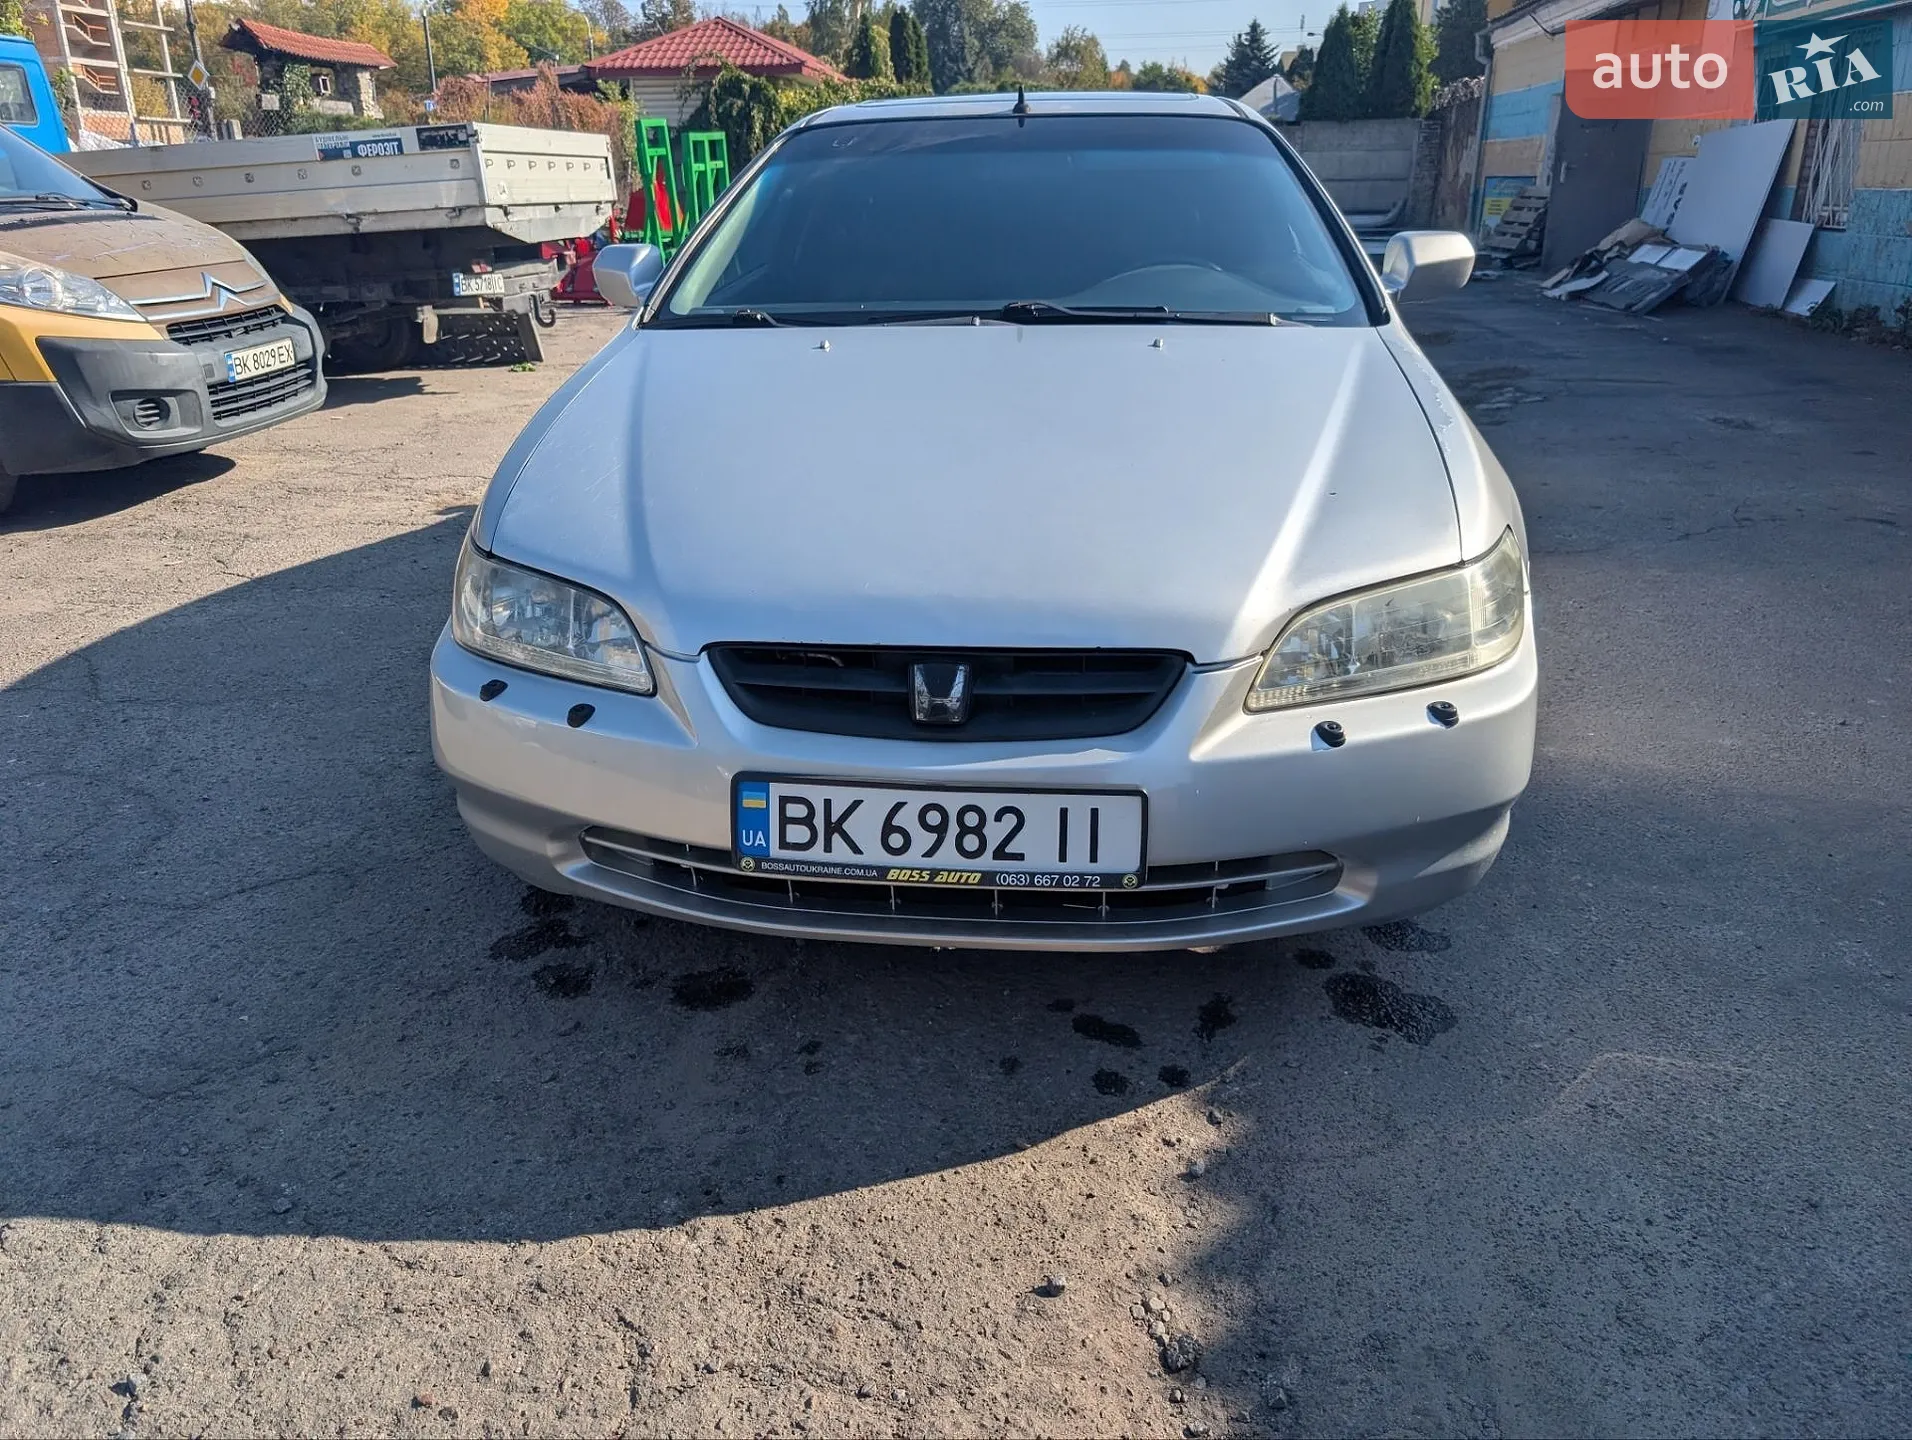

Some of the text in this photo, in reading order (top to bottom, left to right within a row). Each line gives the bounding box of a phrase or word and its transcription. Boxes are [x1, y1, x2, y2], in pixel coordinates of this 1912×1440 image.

[357, 141, 399, 157] ФЕРОЗІТ
[234, 344, 293, 375] BK 8029 EX
[778, 795, 1099, 863] BK 6982 II
[742, 829, 767, 847] UA
[761, 861, 878, 877] BOSSAUTOUKRAINE.COM.UA
[887, 868, 982, 884] BOSS AUTO
[996, 873, 1101, 888] (063) 667 02 72
